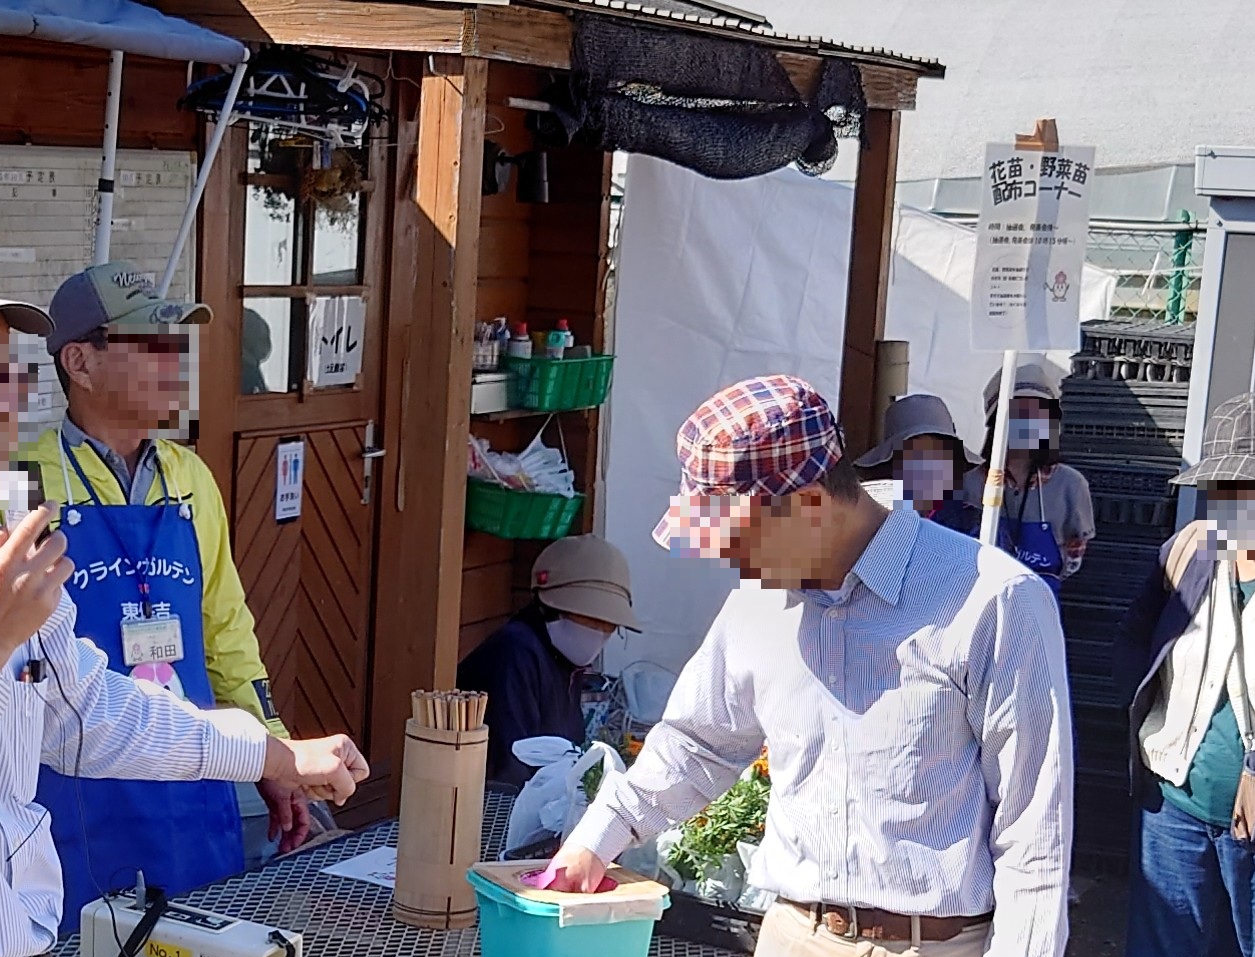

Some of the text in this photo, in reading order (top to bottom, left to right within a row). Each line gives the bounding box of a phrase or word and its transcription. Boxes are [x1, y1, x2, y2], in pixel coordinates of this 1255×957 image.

[990, 156, 1090, 184] 花苗・野菜苗
[991, 180, 1082, 206] 配布コーナー
[73, 557, 194, 590] クラインガルテン
[149, 644, 177, 660] 和田
